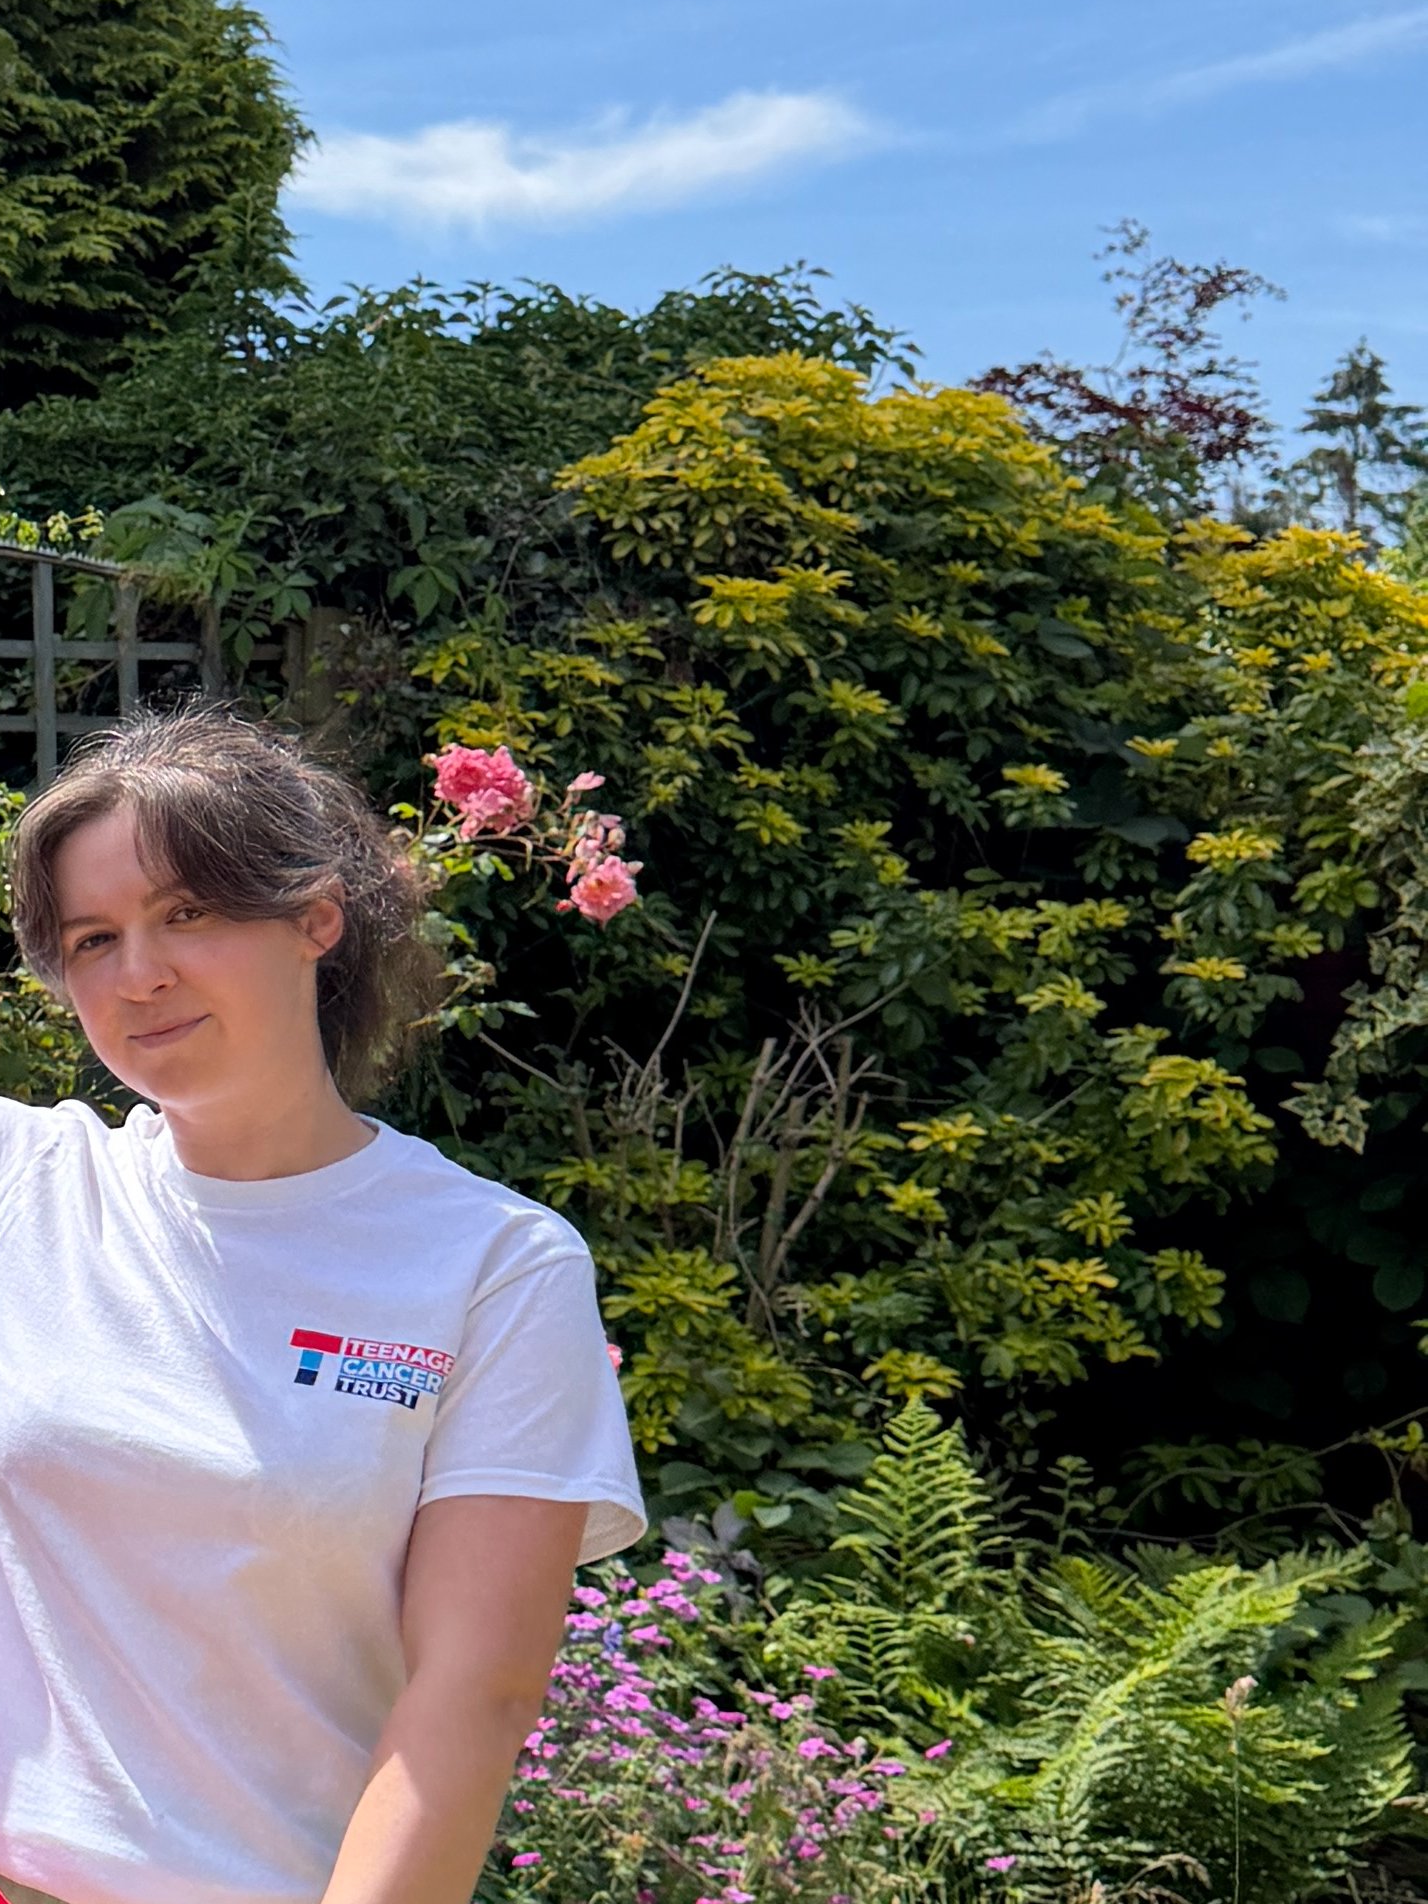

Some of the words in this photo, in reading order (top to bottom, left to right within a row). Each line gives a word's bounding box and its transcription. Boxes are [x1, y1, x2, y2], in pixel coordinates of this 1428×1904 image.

[348, 1338, 456, 1375] TEENAGE
[339, 1377, 418, 1407] TRUST
[343, 1358, 441, 1394] CANCER
